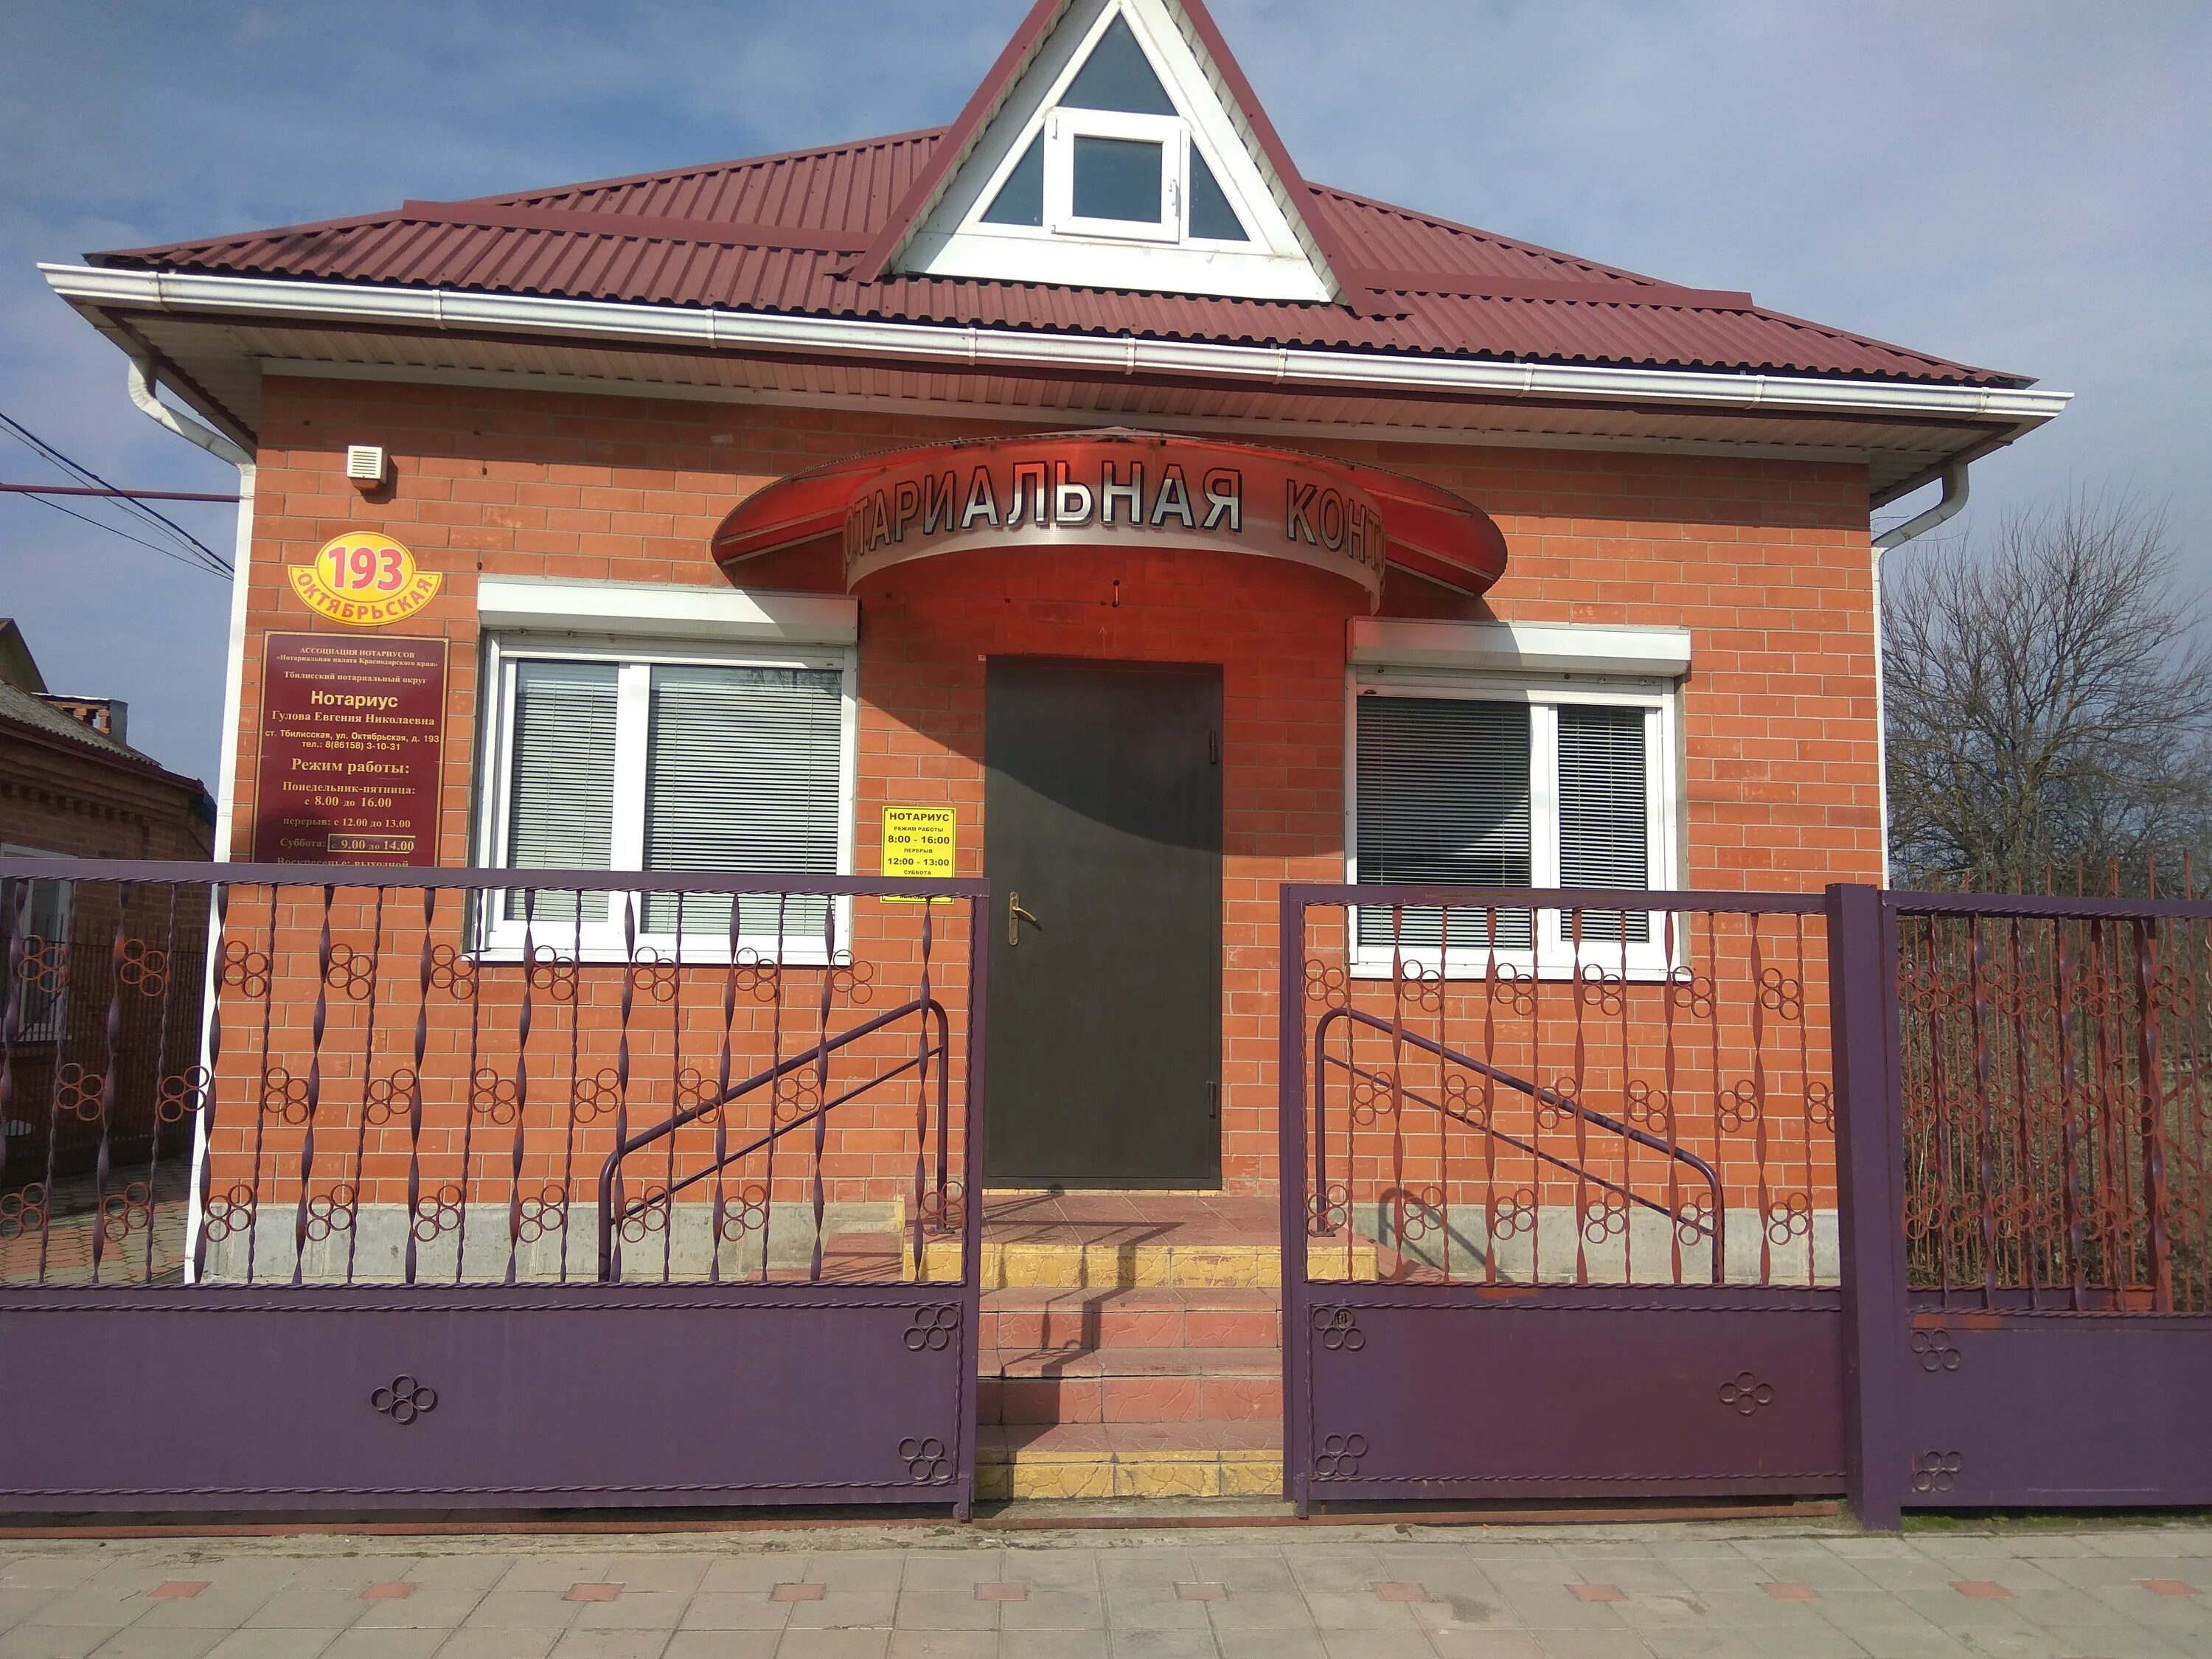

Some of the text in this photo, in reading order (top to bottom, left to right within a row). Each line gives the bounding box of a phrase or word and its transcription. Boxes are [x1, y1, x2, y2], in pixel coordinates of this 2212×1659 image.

[844, 459, 1242, 566] ОТАРИАЛЬНАЯ
[328, 546, 403, 591] 193
[297, 573, 433, 619] ОКТЯБРЬСКАЯ
[300, 647, 415, 658] АССОЦИАЦИЯ НОТАРИУСОВ
[359, 658, 416, 667] Краснодарского
[284, 671, 428, 686] Тбилисский нотариальный округ
[310, 690, 399, 710] Нотариус
[271, 710, 435, 726] Гулова Евгения Николаевна
[280, 729, 333, 740] Тбилисская,
[335, 733, 349, 741] ул.
[351, 732, 408, 742] Октябрьская,
[411, 736, 420, 744] д.
[423, 735, 439, 743] 193
[325, 741, 364, 751] 8(86158)
[366, 742, 400, 751] 3-10-31
[291, 758, 410, 775] Режим работы:
[282, 781, 416, 795] Понедельник-пятница:
[314, 796, 339, 807] 8.00
[343, 799, 355, 807] до
[361, 797, 392, 808] 16.00
[283, 817, 331, 827] перерыв:
[342, 818, 368, 827] 12.00
[369, 820, 382, 828] до
[385, 818, 411, 829] 13.00
[889, 813, 950, 821] НОТАРИУС
[280, 838, 326, 849] Суббота:
[341, 839, 366, 850] 9.00
[383, 841, 414, 851] 14.00
[888, 835, 911, 844] 8:00
[920, 835, 950, 844] 16:00
[887, 858, 914, 866] 12:00
[923, 858, 950, 866] 13:00
